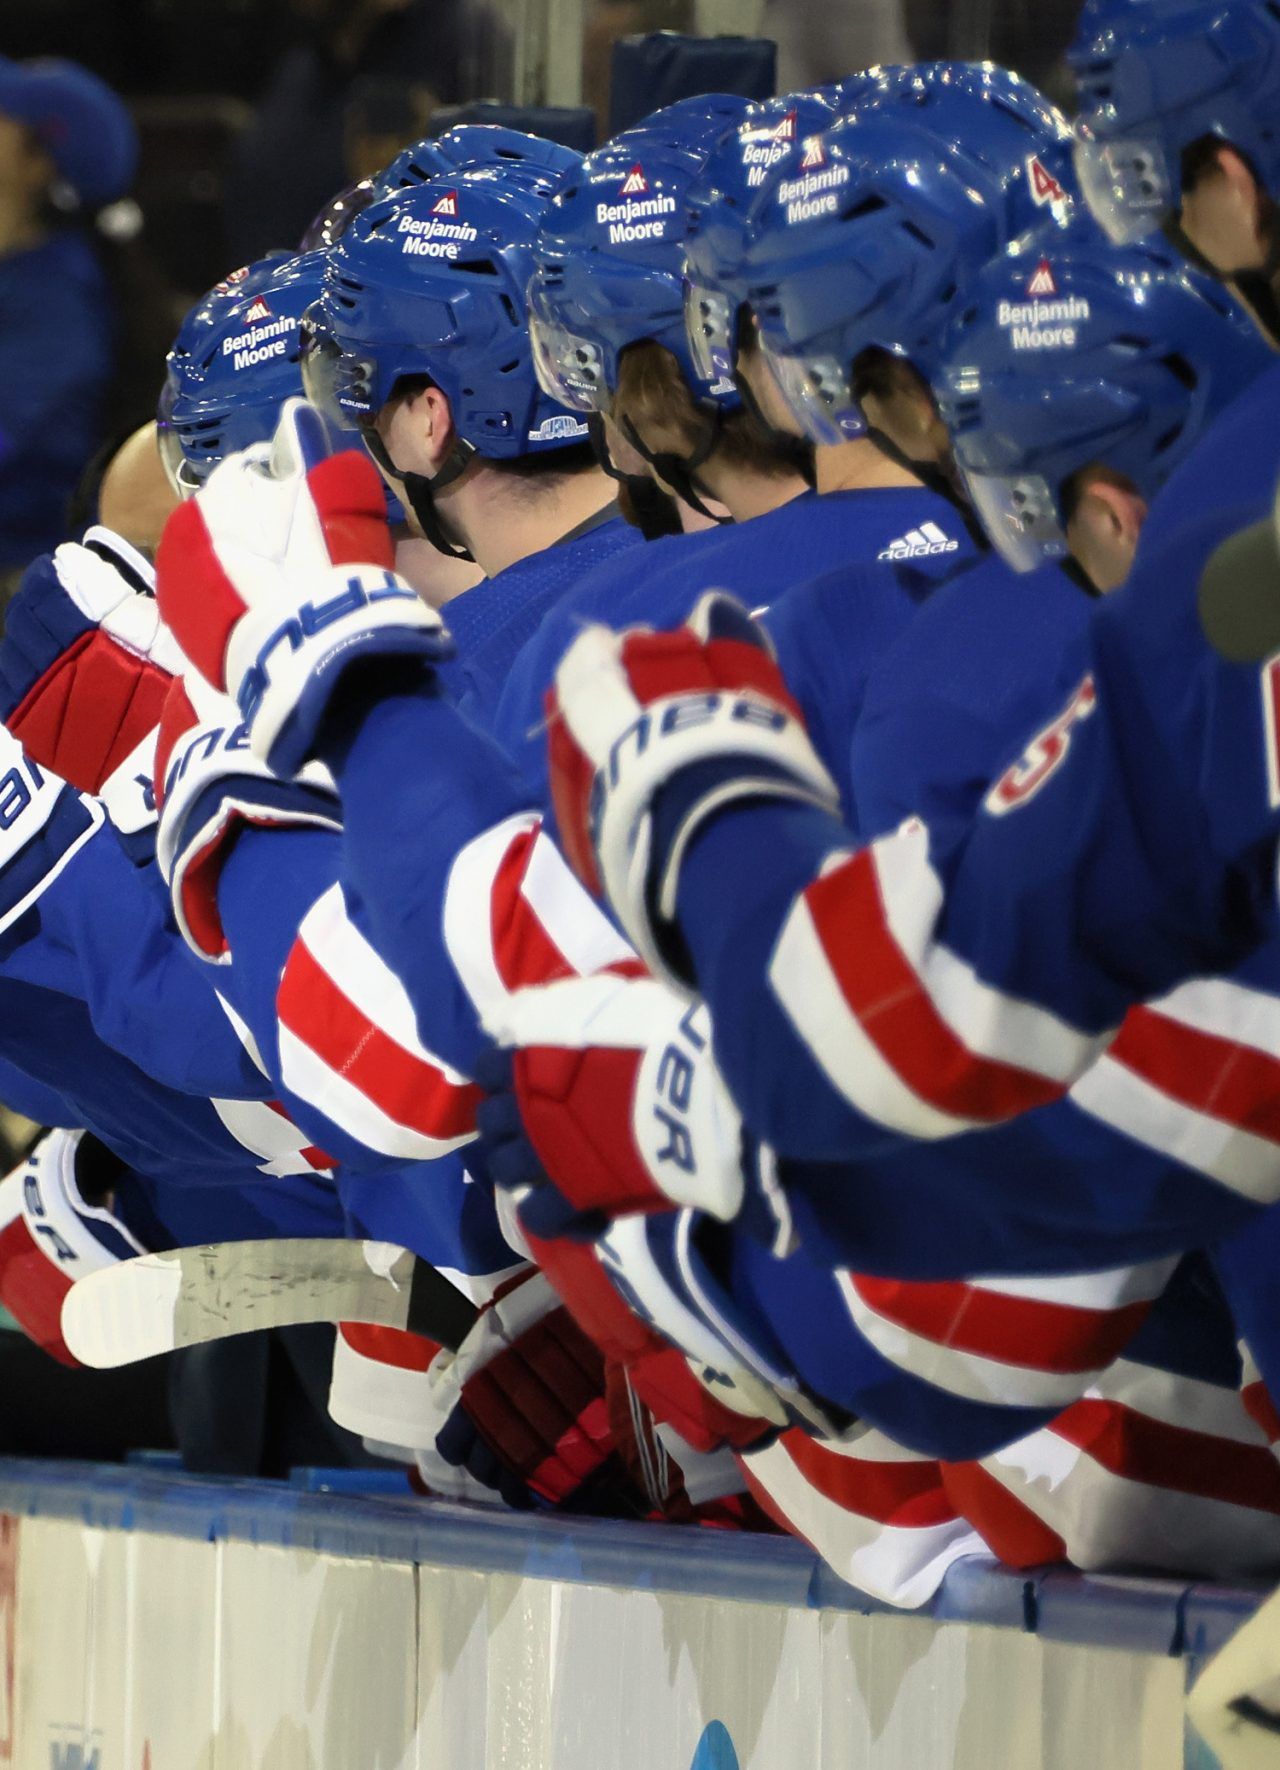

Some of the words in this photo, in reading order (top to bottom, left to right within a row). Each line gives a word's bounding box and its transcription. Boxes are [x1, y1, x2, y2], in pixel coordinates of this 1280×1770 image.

[779, 165, 849, 204] Benjamin
[597, 193, 676, 224] Benjamin
[788, 194, 837, 224] Moore
[398, 216, 477, 241] Benjamin
[609, 221, 664, 244] Moore
[402, 236, 459, 260] Moore
[998, 296, 1089, 326] Benjamin
[223, 315, 296, 356] Benjamin
[1013, 328, 1075, 349] Moore
[234, 340, 287, 371] Moore
[877, 540, 959, 560] adidas
